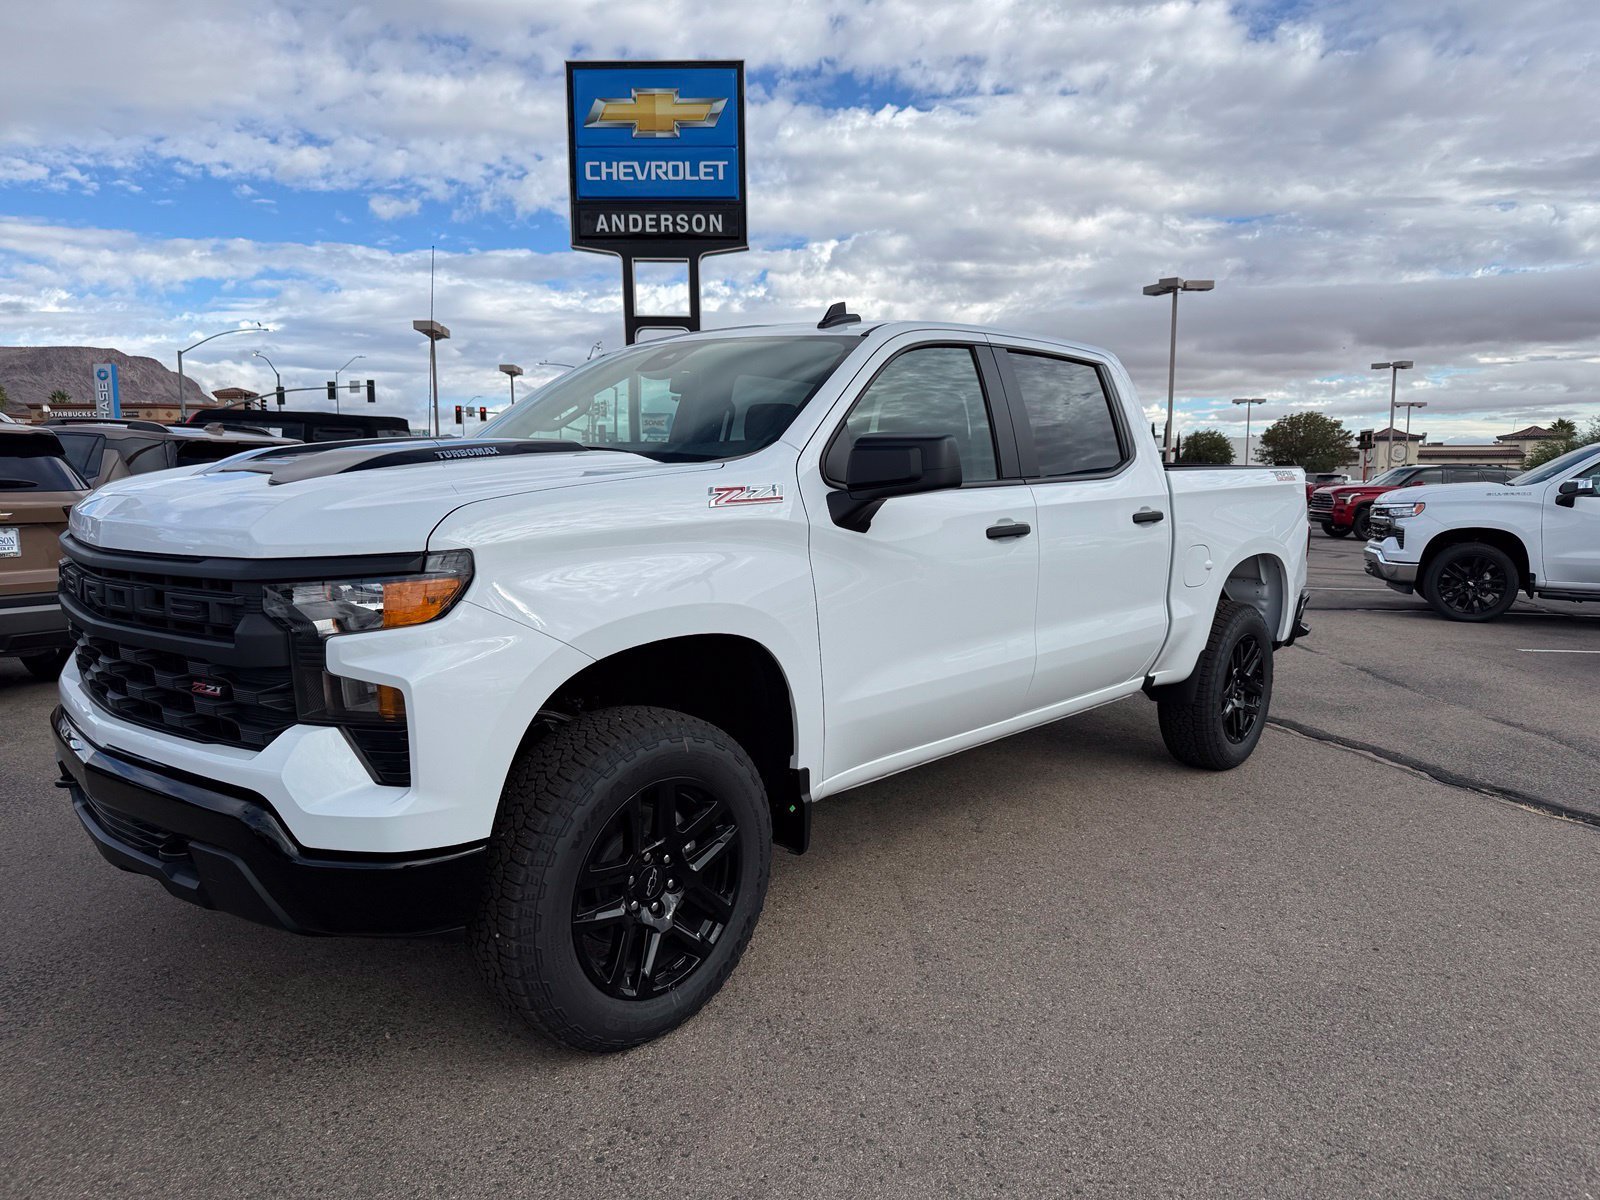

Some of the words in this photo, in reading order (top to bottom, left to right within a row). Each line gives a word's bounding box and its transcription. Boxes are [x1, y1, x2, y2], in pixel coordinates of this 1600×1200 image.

[585, 161, 728, 181] CHEVROLET
[595, 213, 723, 233] ANDERSON
[98, 382, 110, 420] HASE
[49, 410, 92, 418] STARBUCKS
[434, 446, 500, 459] TURBOMAX
[708, 484, 784, 508] Z71
